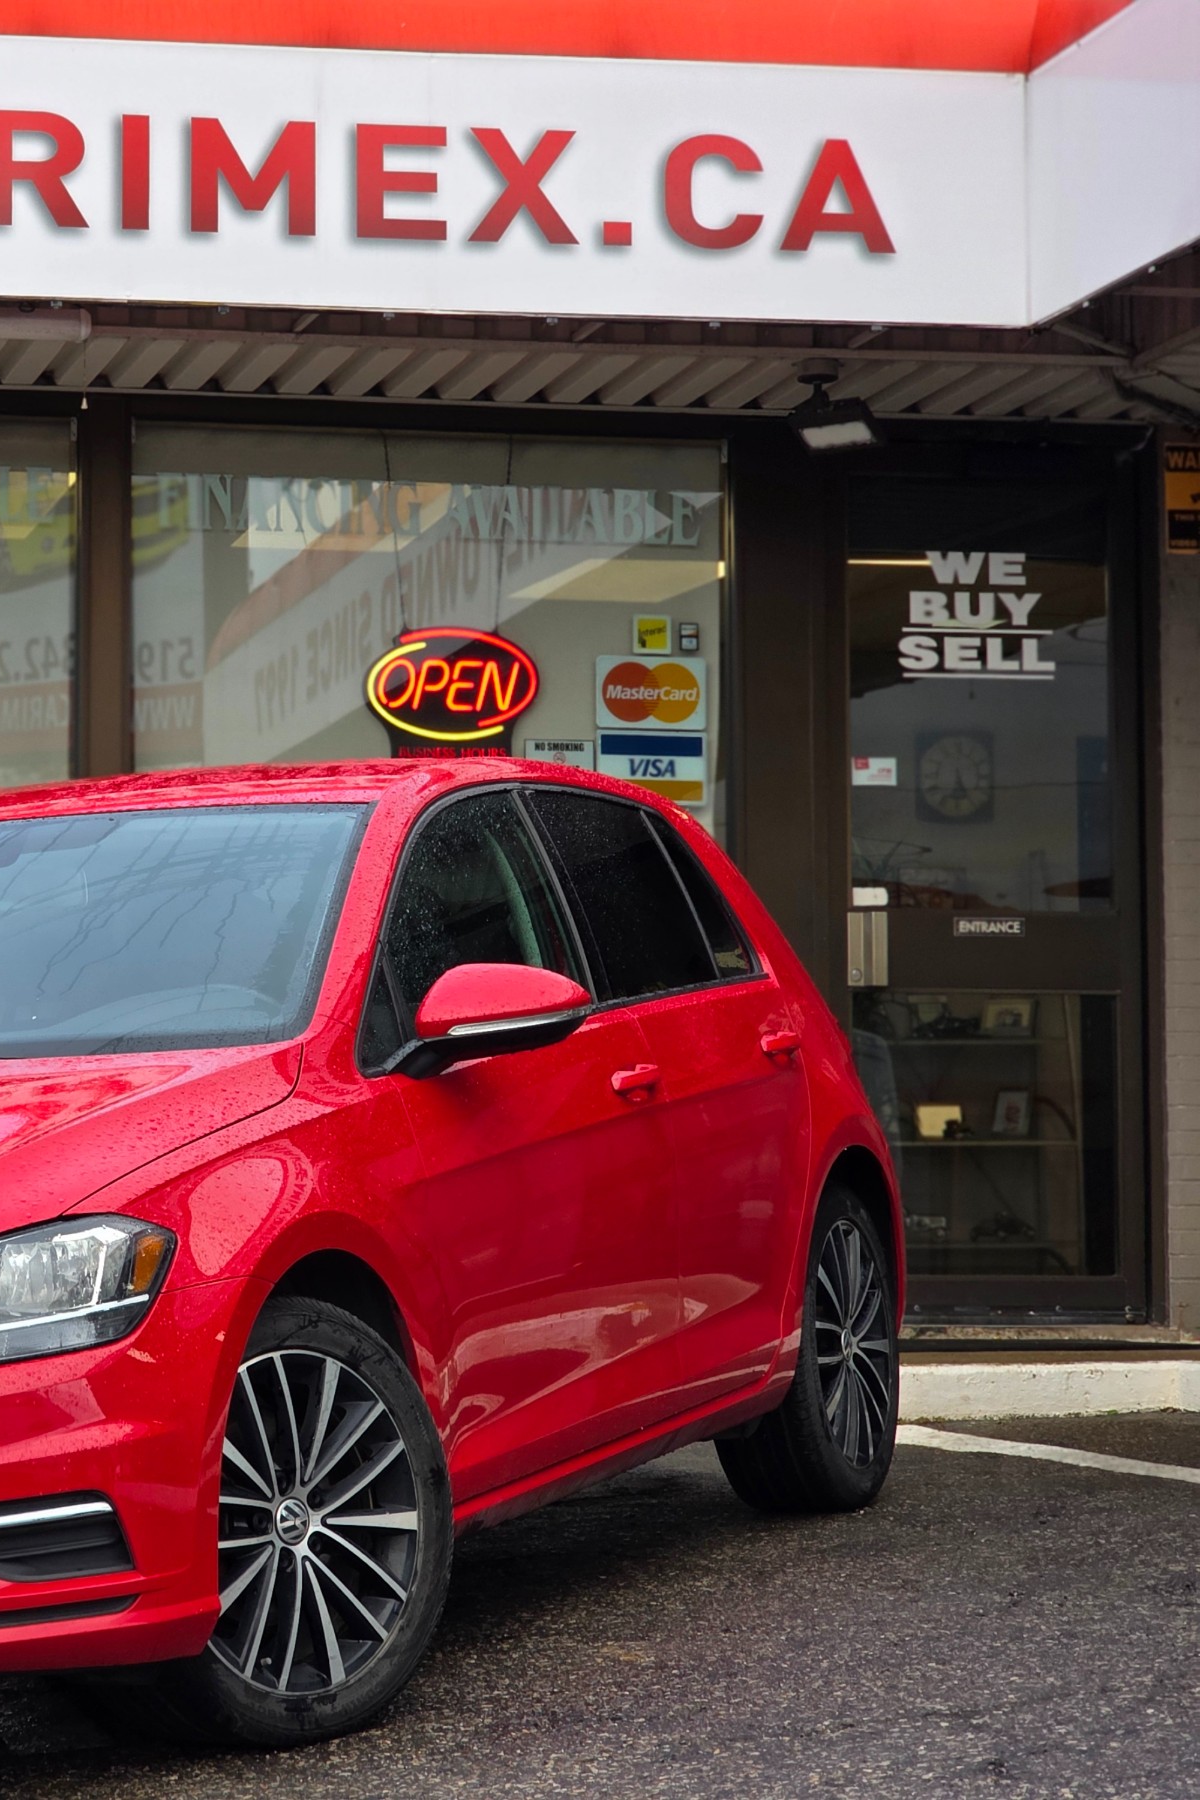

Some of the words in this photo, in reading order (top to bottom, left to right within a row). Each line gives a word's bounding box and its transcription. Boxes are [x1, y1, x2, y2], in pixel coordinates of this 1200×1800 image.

[156, 472, 422, 536] FINANCING
[446, 484, 700, 546] AVAILABLE
[925, 551, 1027, 586] WE
[909, 591, 1042, 628] BUY
[898, 635, 1056, 672] SELL
[377, 658, 520, 712] OPEN
[606, 684, 698, 701] MasterCard
[399, 746, 456, 758] BUSINESS
[461, 747, 506, 758] HOURS
[534, 742, 545, 752] NO
[547, 742, 585, 752] SMOKING
[628, 758, 677, 778] VISA
[958, 921, 1021, 934] ENTRANCE
